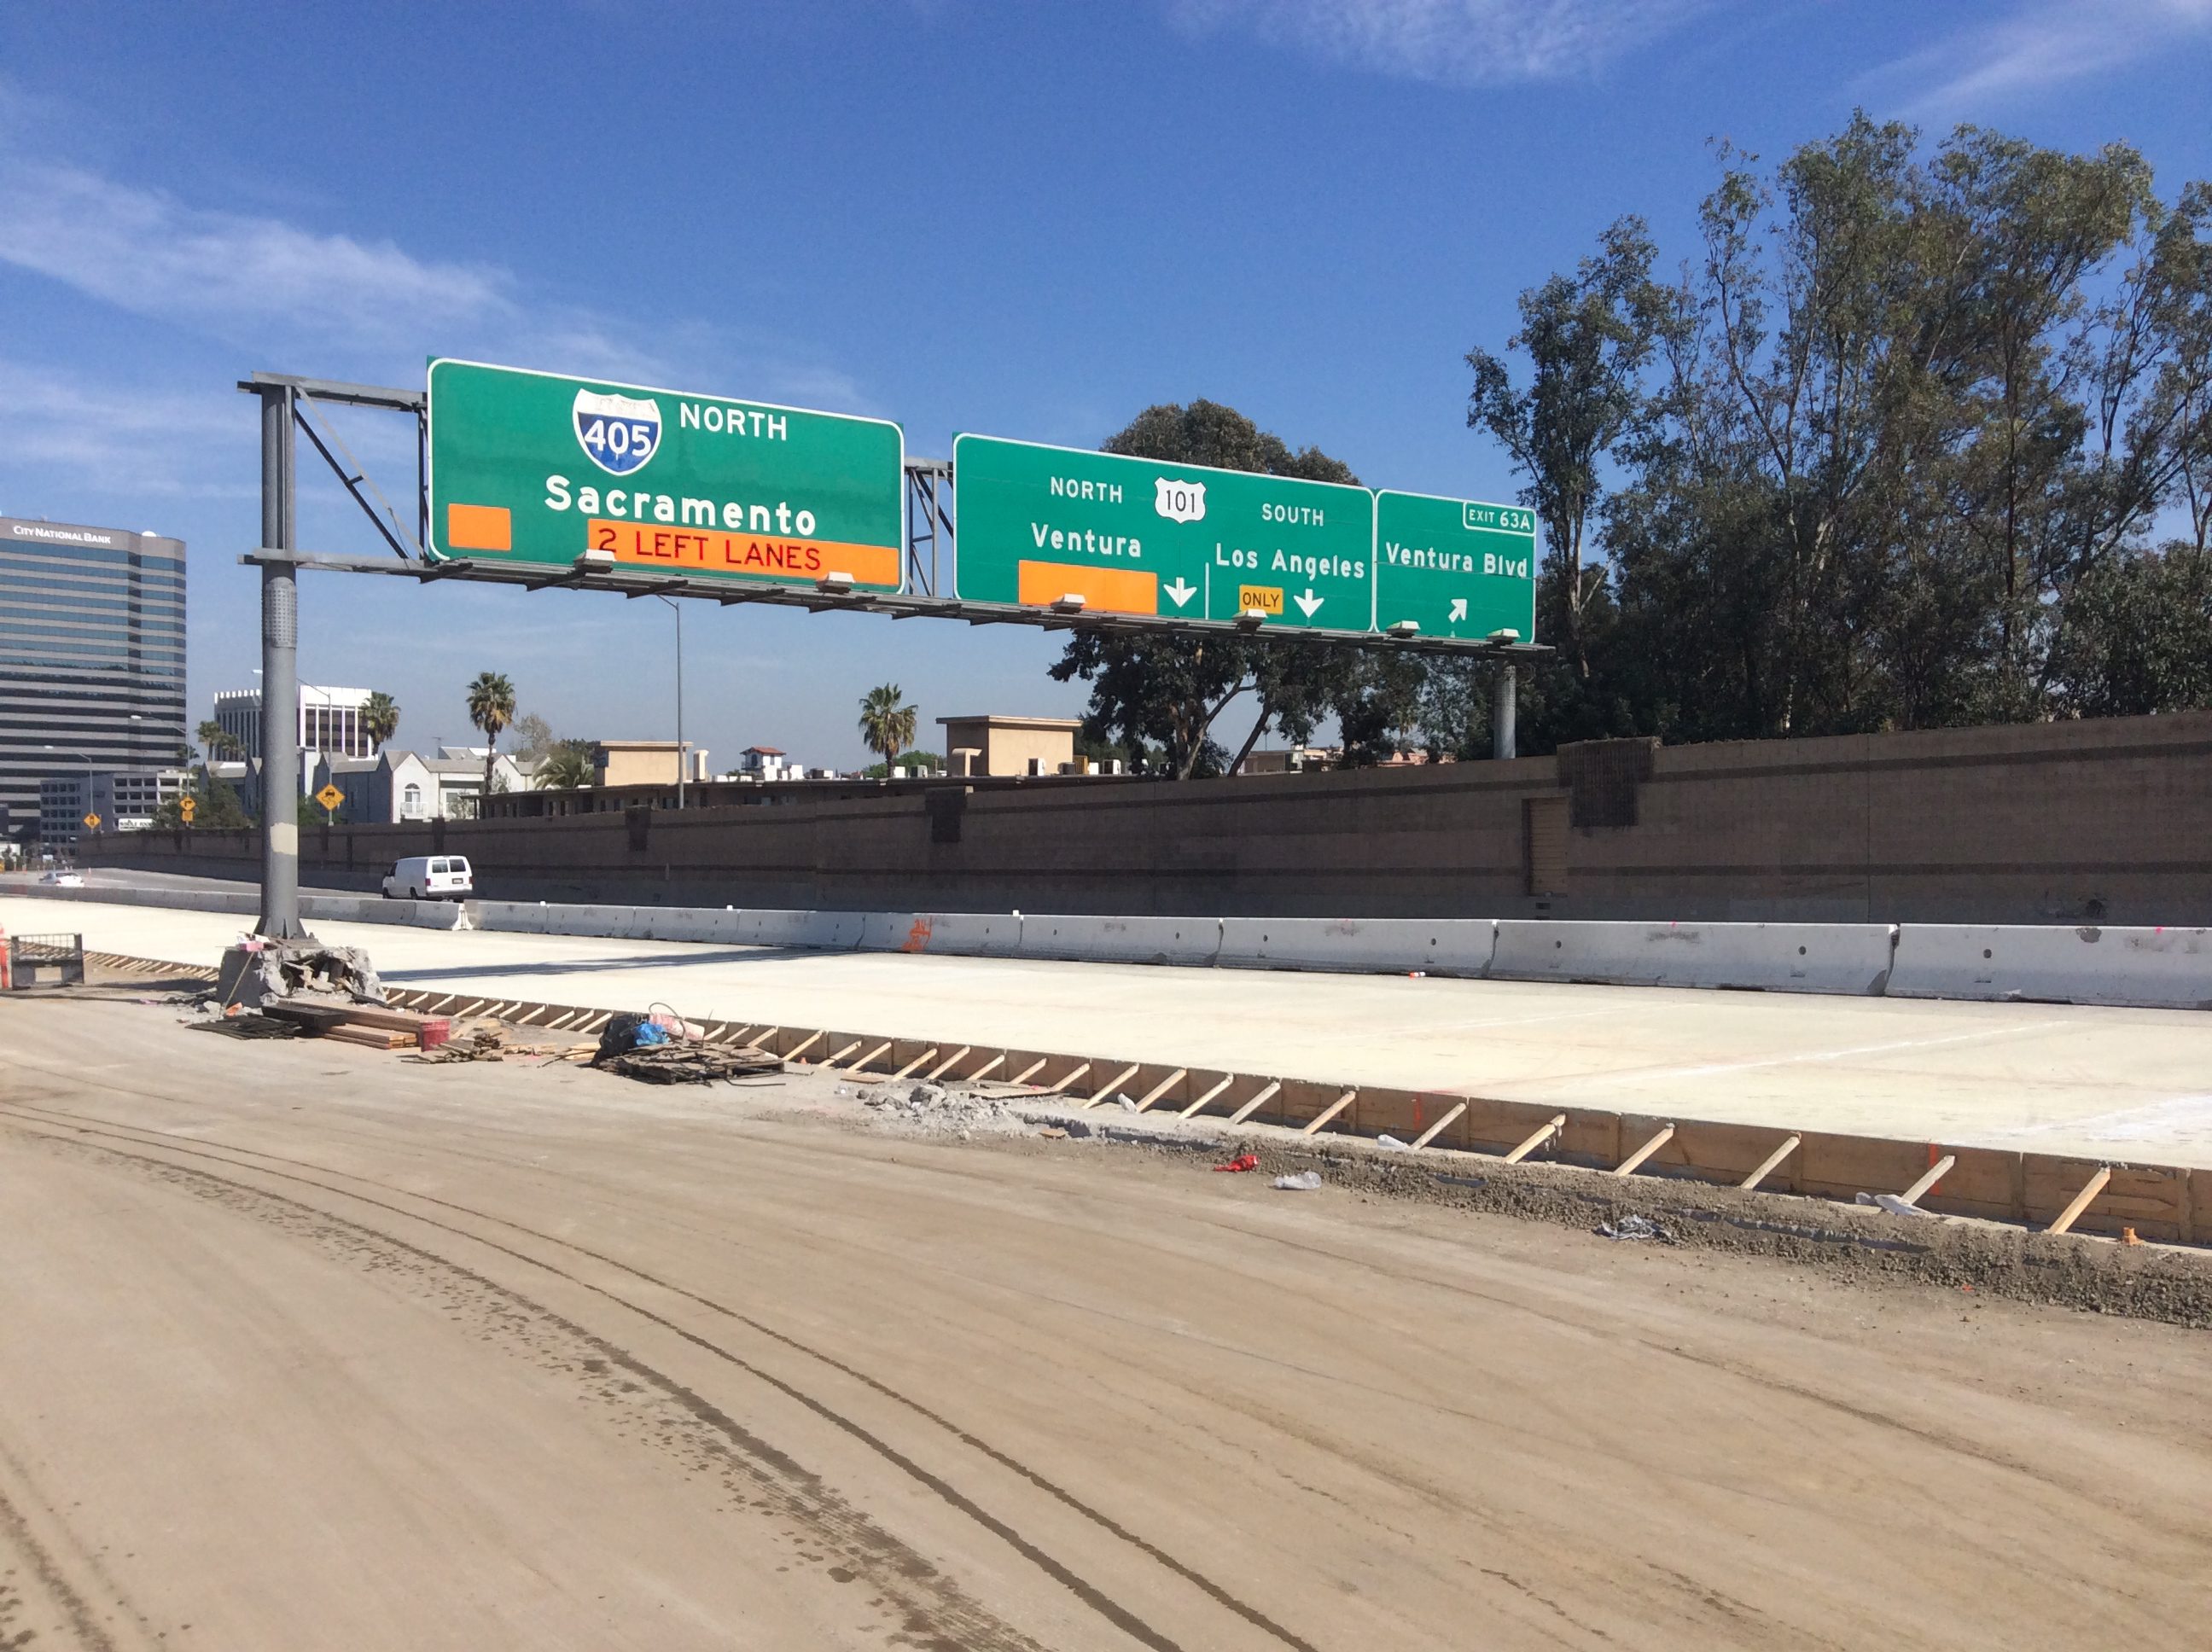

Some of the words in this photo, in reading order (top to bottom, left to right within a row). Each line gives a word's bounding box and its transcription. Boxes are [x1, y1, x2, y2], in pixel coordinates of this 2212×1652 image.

[584, 419, 652, 457] 405
[680, 402, 787, 441] NORTH
[544, 474, 817, 536] Sacramento
[1051, 476, 1123, 503] NORTH
[1166, 489, 1195, 513] 101
[1261, 503, 1324, 527] SOUTH
[1469, 509, 1495, 523] EXIT
[1499, 510, 1531, 530] 63A
[13, 525, 34, 536] CITY
[34, 527, 83, 542] NATIONAL
[84, 532, 112, 544] BANK
[597, 527, 617, 553] 2
[636, 531, 709, 561] LEFT
[725, 538, 822, 571] LANES
[1030, 521, 1142, 558] Ventura
[1215, 542, 1259, 569] Los
[1271, 549, 1365, 582] Angeles
[1385, 541, 1474, 573] Ventura
[1483, 552, 1528, 579] Blvd
[1242, 591, 1280, 608] ONLY
